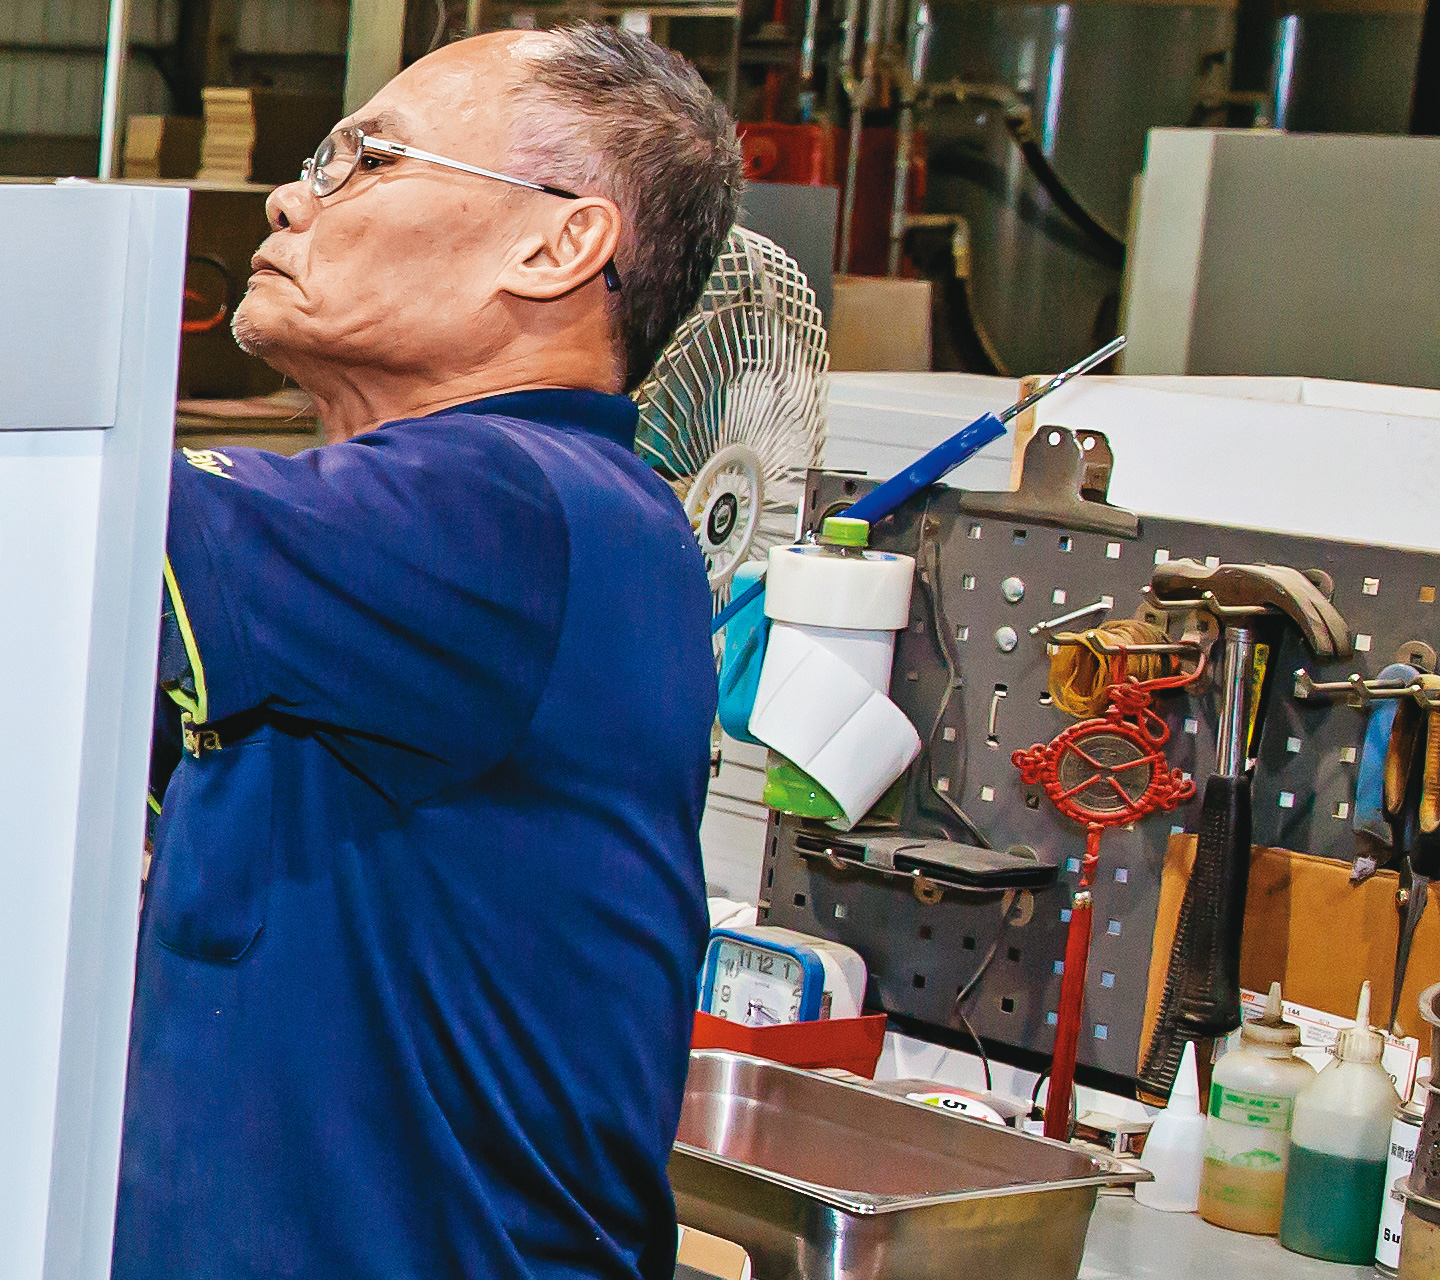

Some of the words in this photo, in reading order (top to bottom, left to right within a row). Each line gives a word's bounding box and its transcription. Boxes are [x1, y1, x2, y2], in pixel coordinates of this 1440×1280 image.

[757, 953, 773, 975] 12
[783, 962, 791, 980] 1
[720, 984, 732, 1003] 9
